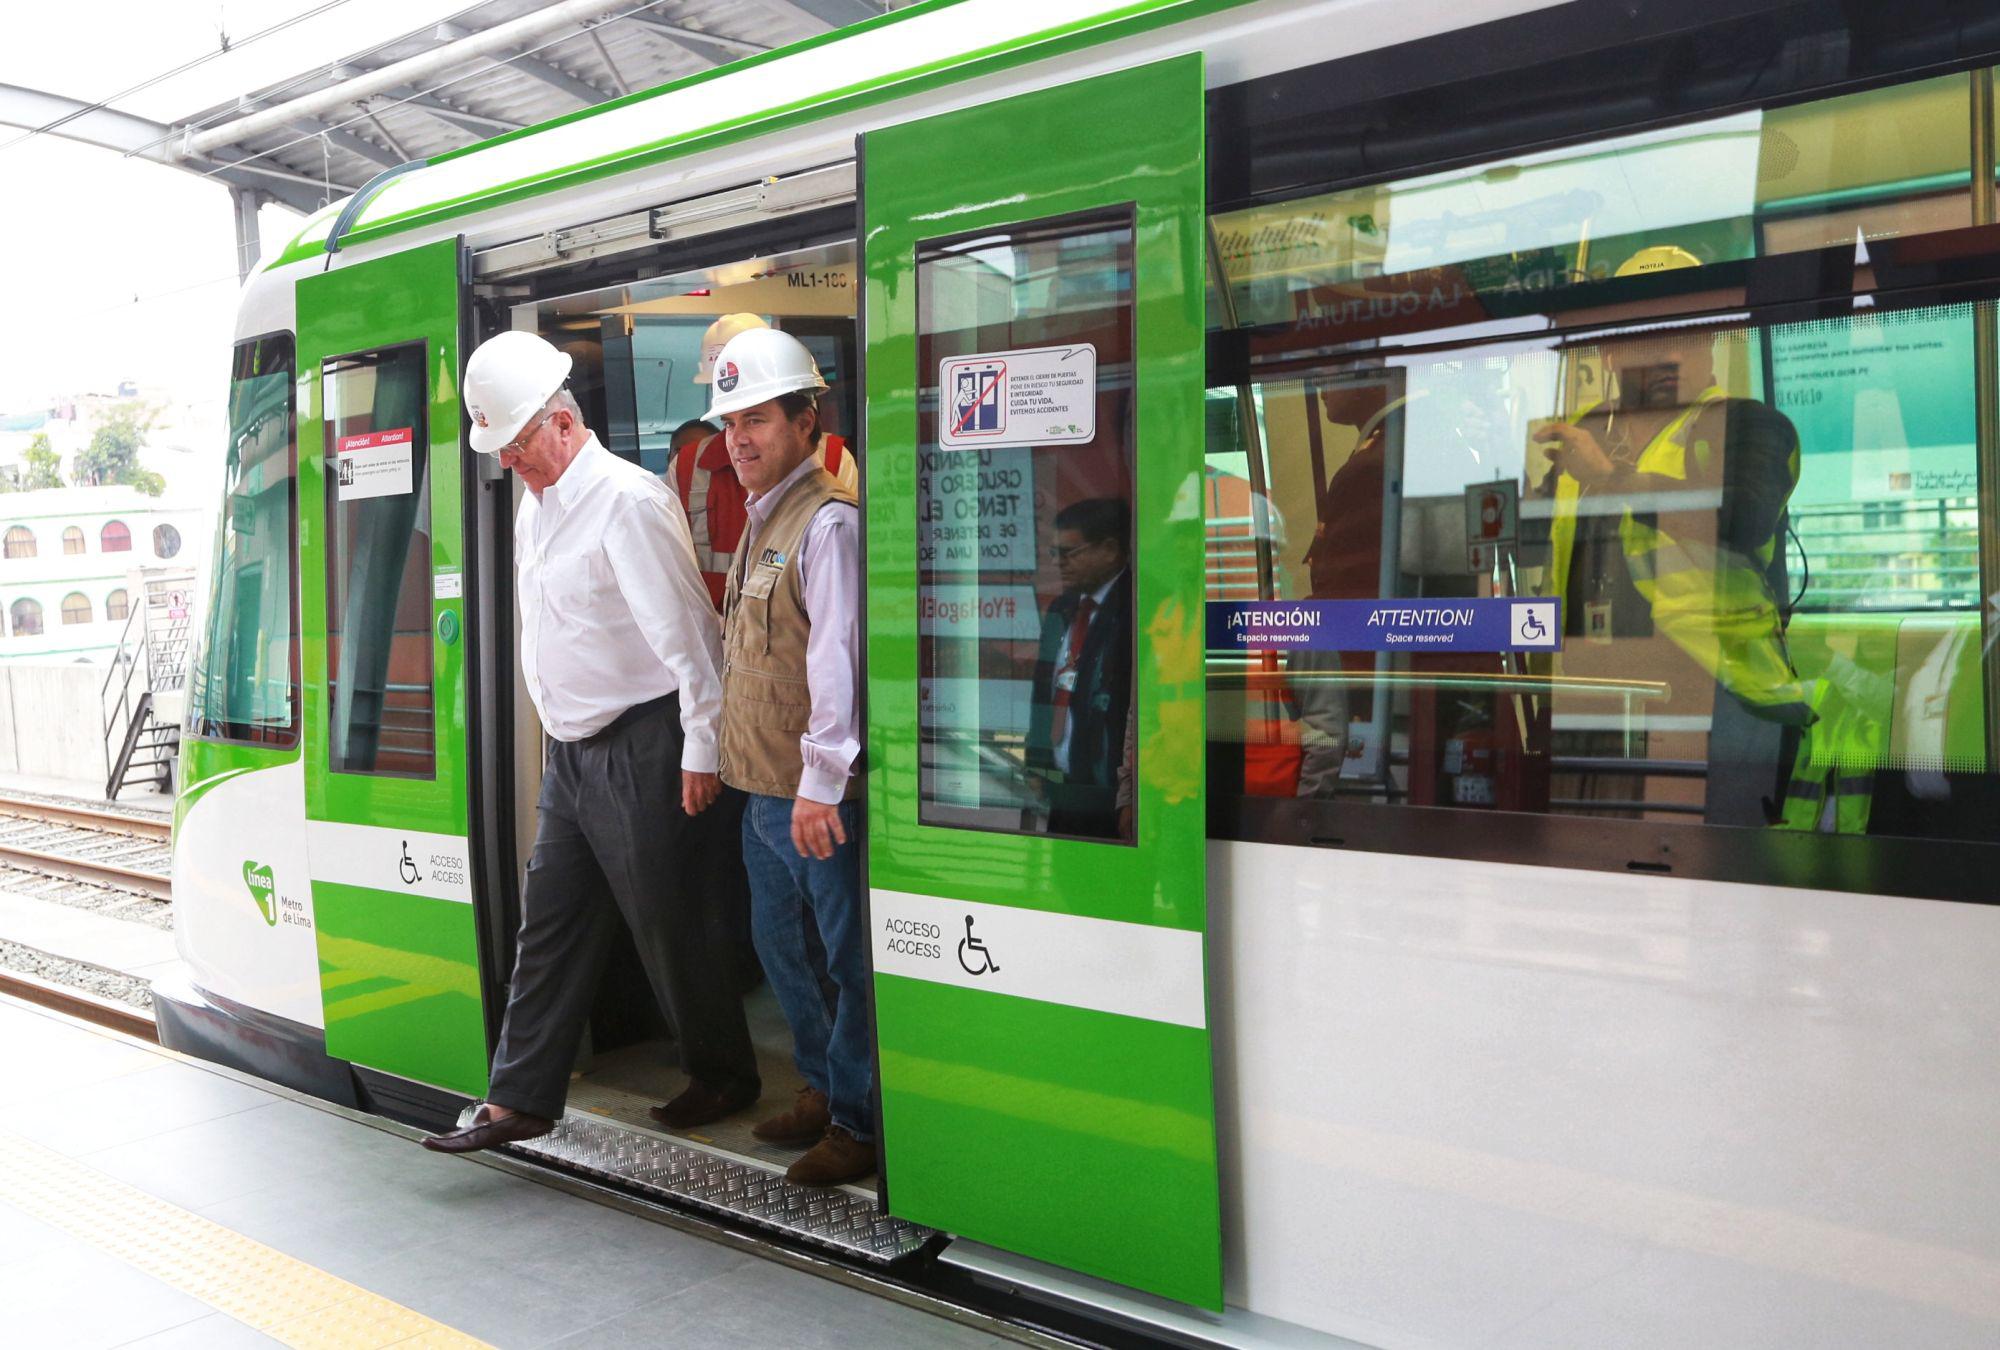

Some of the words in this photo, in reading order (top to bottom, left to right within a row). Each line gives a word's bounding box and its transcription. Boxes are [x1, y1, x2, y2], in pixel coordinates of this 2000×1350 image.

[722, 379, 735, 388] MTC
[761, 548, 778, 564] MTC
[1227, 606, 1320, 630] ¡ATENCIÓN!
[1367, 609, 1474, 626] ATTENTION!
[1236, 634, 1268, 643] Espacio
[1270, 634, 1310, 642] reservado
[1386, 633, 1413, 644] Space
[1415, 633, 1454, 642] reserved
[430, 855, 463, 869] ACCESO
[432, 870, 464, 885] ACCESS
[265, 893, 274, 920] 1
[281, 896, 303, 912] Metro
[282, 911, 292, 923] de
[293, 914, 312, 928] Lima
[885, 918, 940, 939] ACCESO
[887, 938, 940, 959] ACCESS
